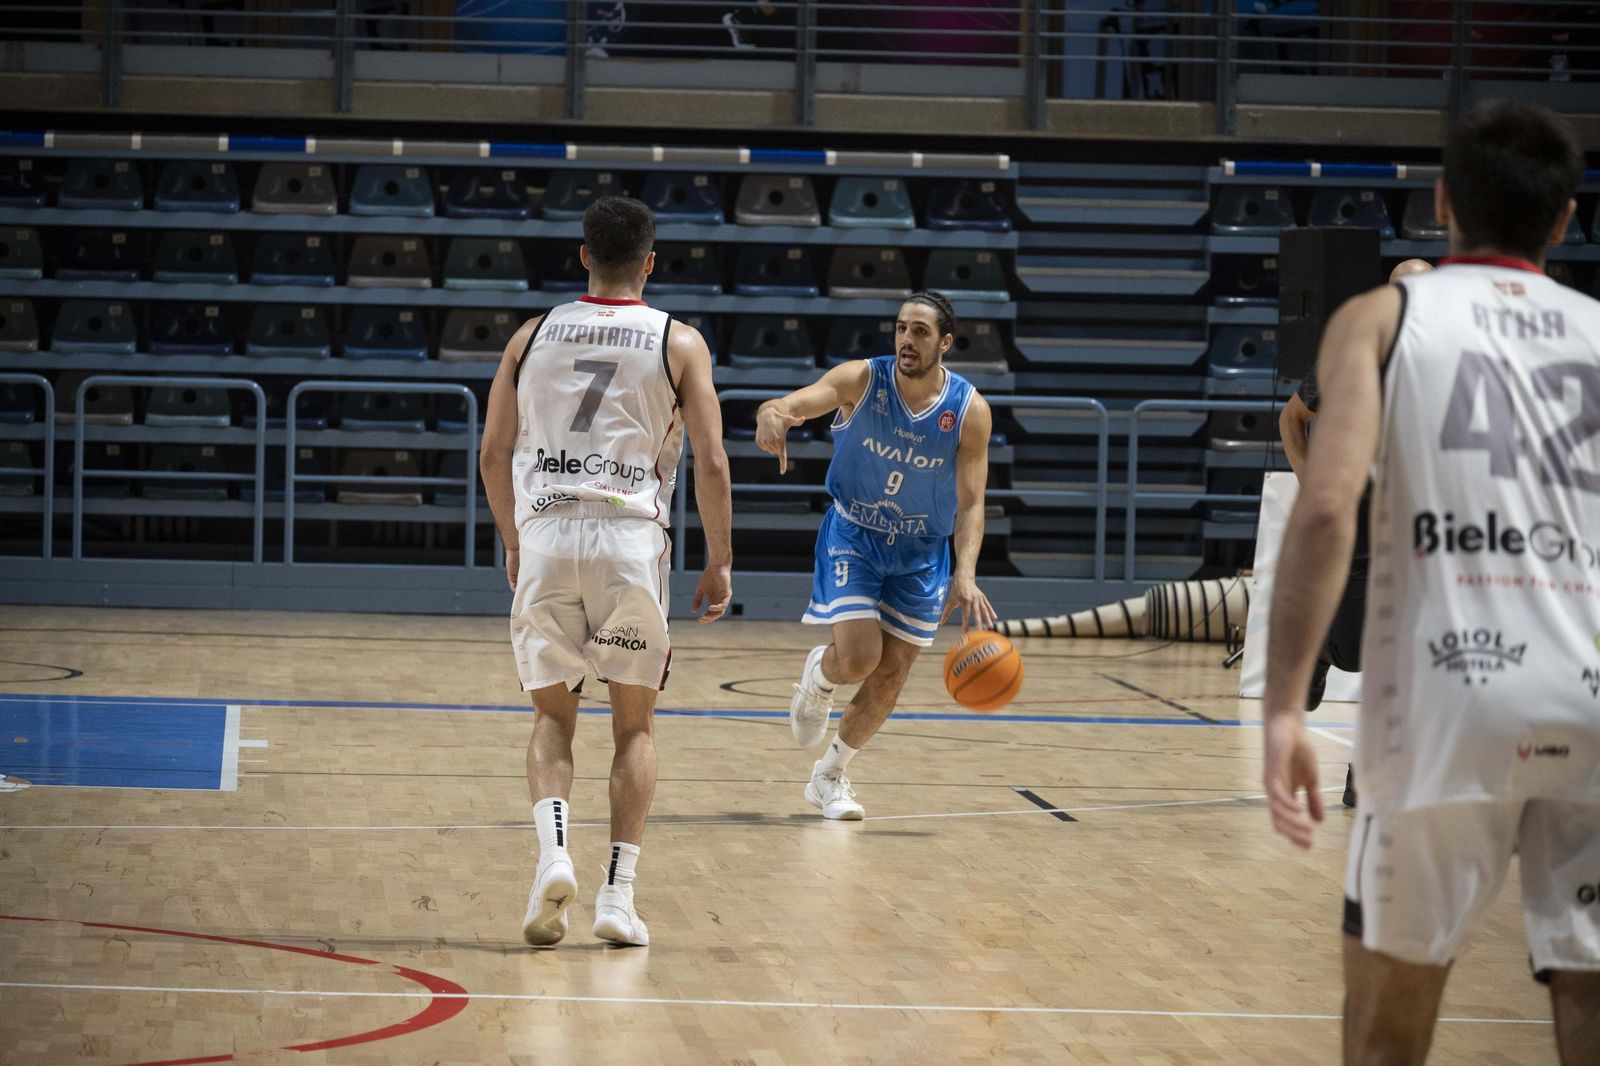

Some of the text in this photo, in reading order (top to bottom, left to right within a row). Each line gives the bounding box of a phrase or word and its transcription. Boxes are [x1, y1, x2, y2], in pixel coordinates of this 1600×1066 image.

[545, 324, 656, 351] AIZPITARTE
[569, 359, 619, 432] 7
[893, 426, 926, 443] Huelva
[1439, 350, 1600, 495] 42
[884, 471, 904, 495] 9
[835, 561, 849, 587] 9
[591, 635, 647, 651] IPUZKOA
